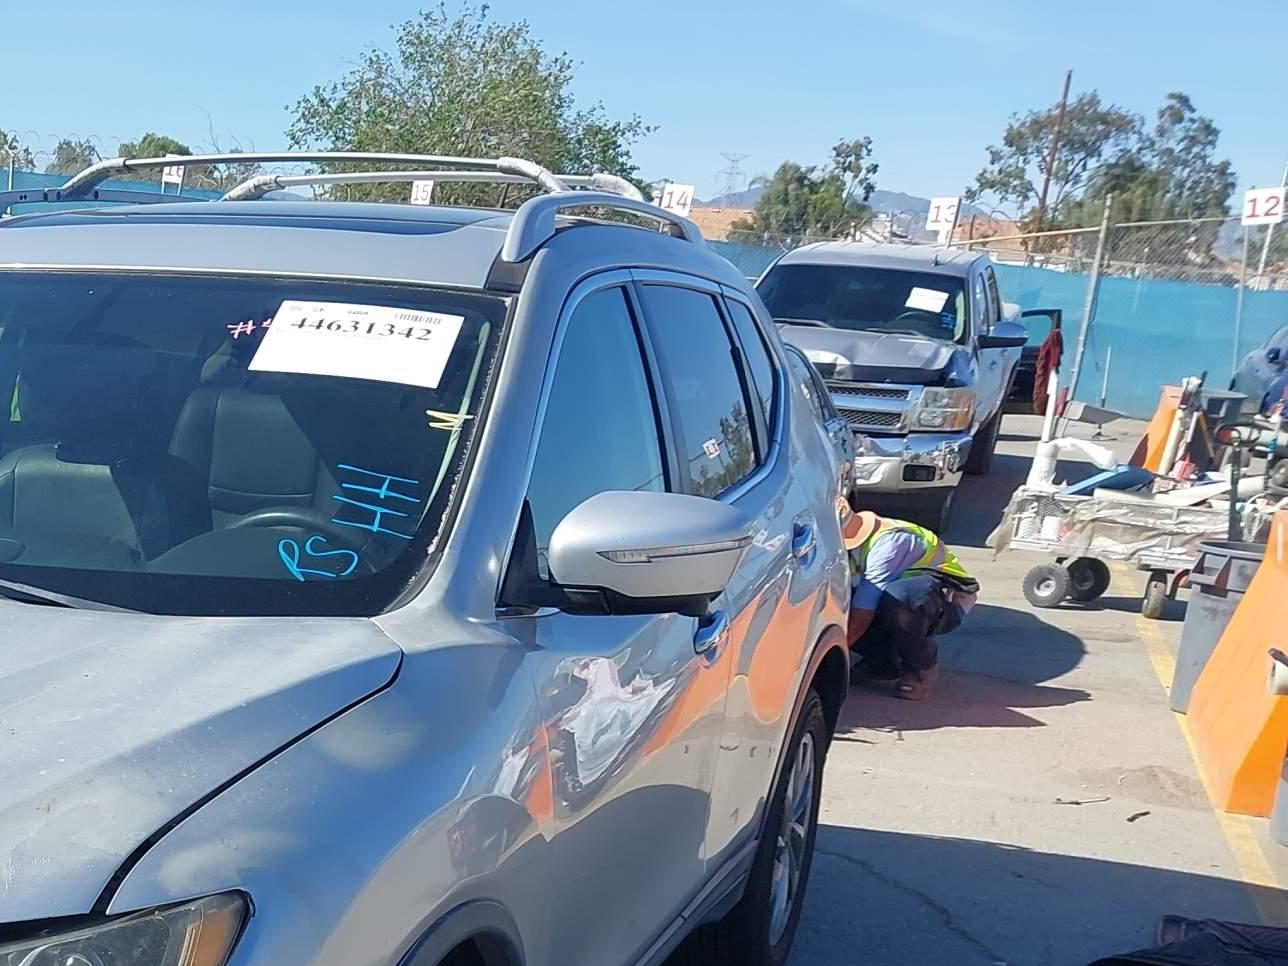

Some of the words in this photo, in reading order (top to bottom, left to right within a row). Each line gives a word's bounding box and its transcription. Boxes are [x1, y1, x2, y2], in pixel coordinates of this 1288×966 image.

[412, 183, 431, 202] 15
[663, 190, 689, 209] 14
[1244, 195, 1281, 219] 12
[290, 317, 433, 342] 44631342
[278, 535, 360, 583] RS
